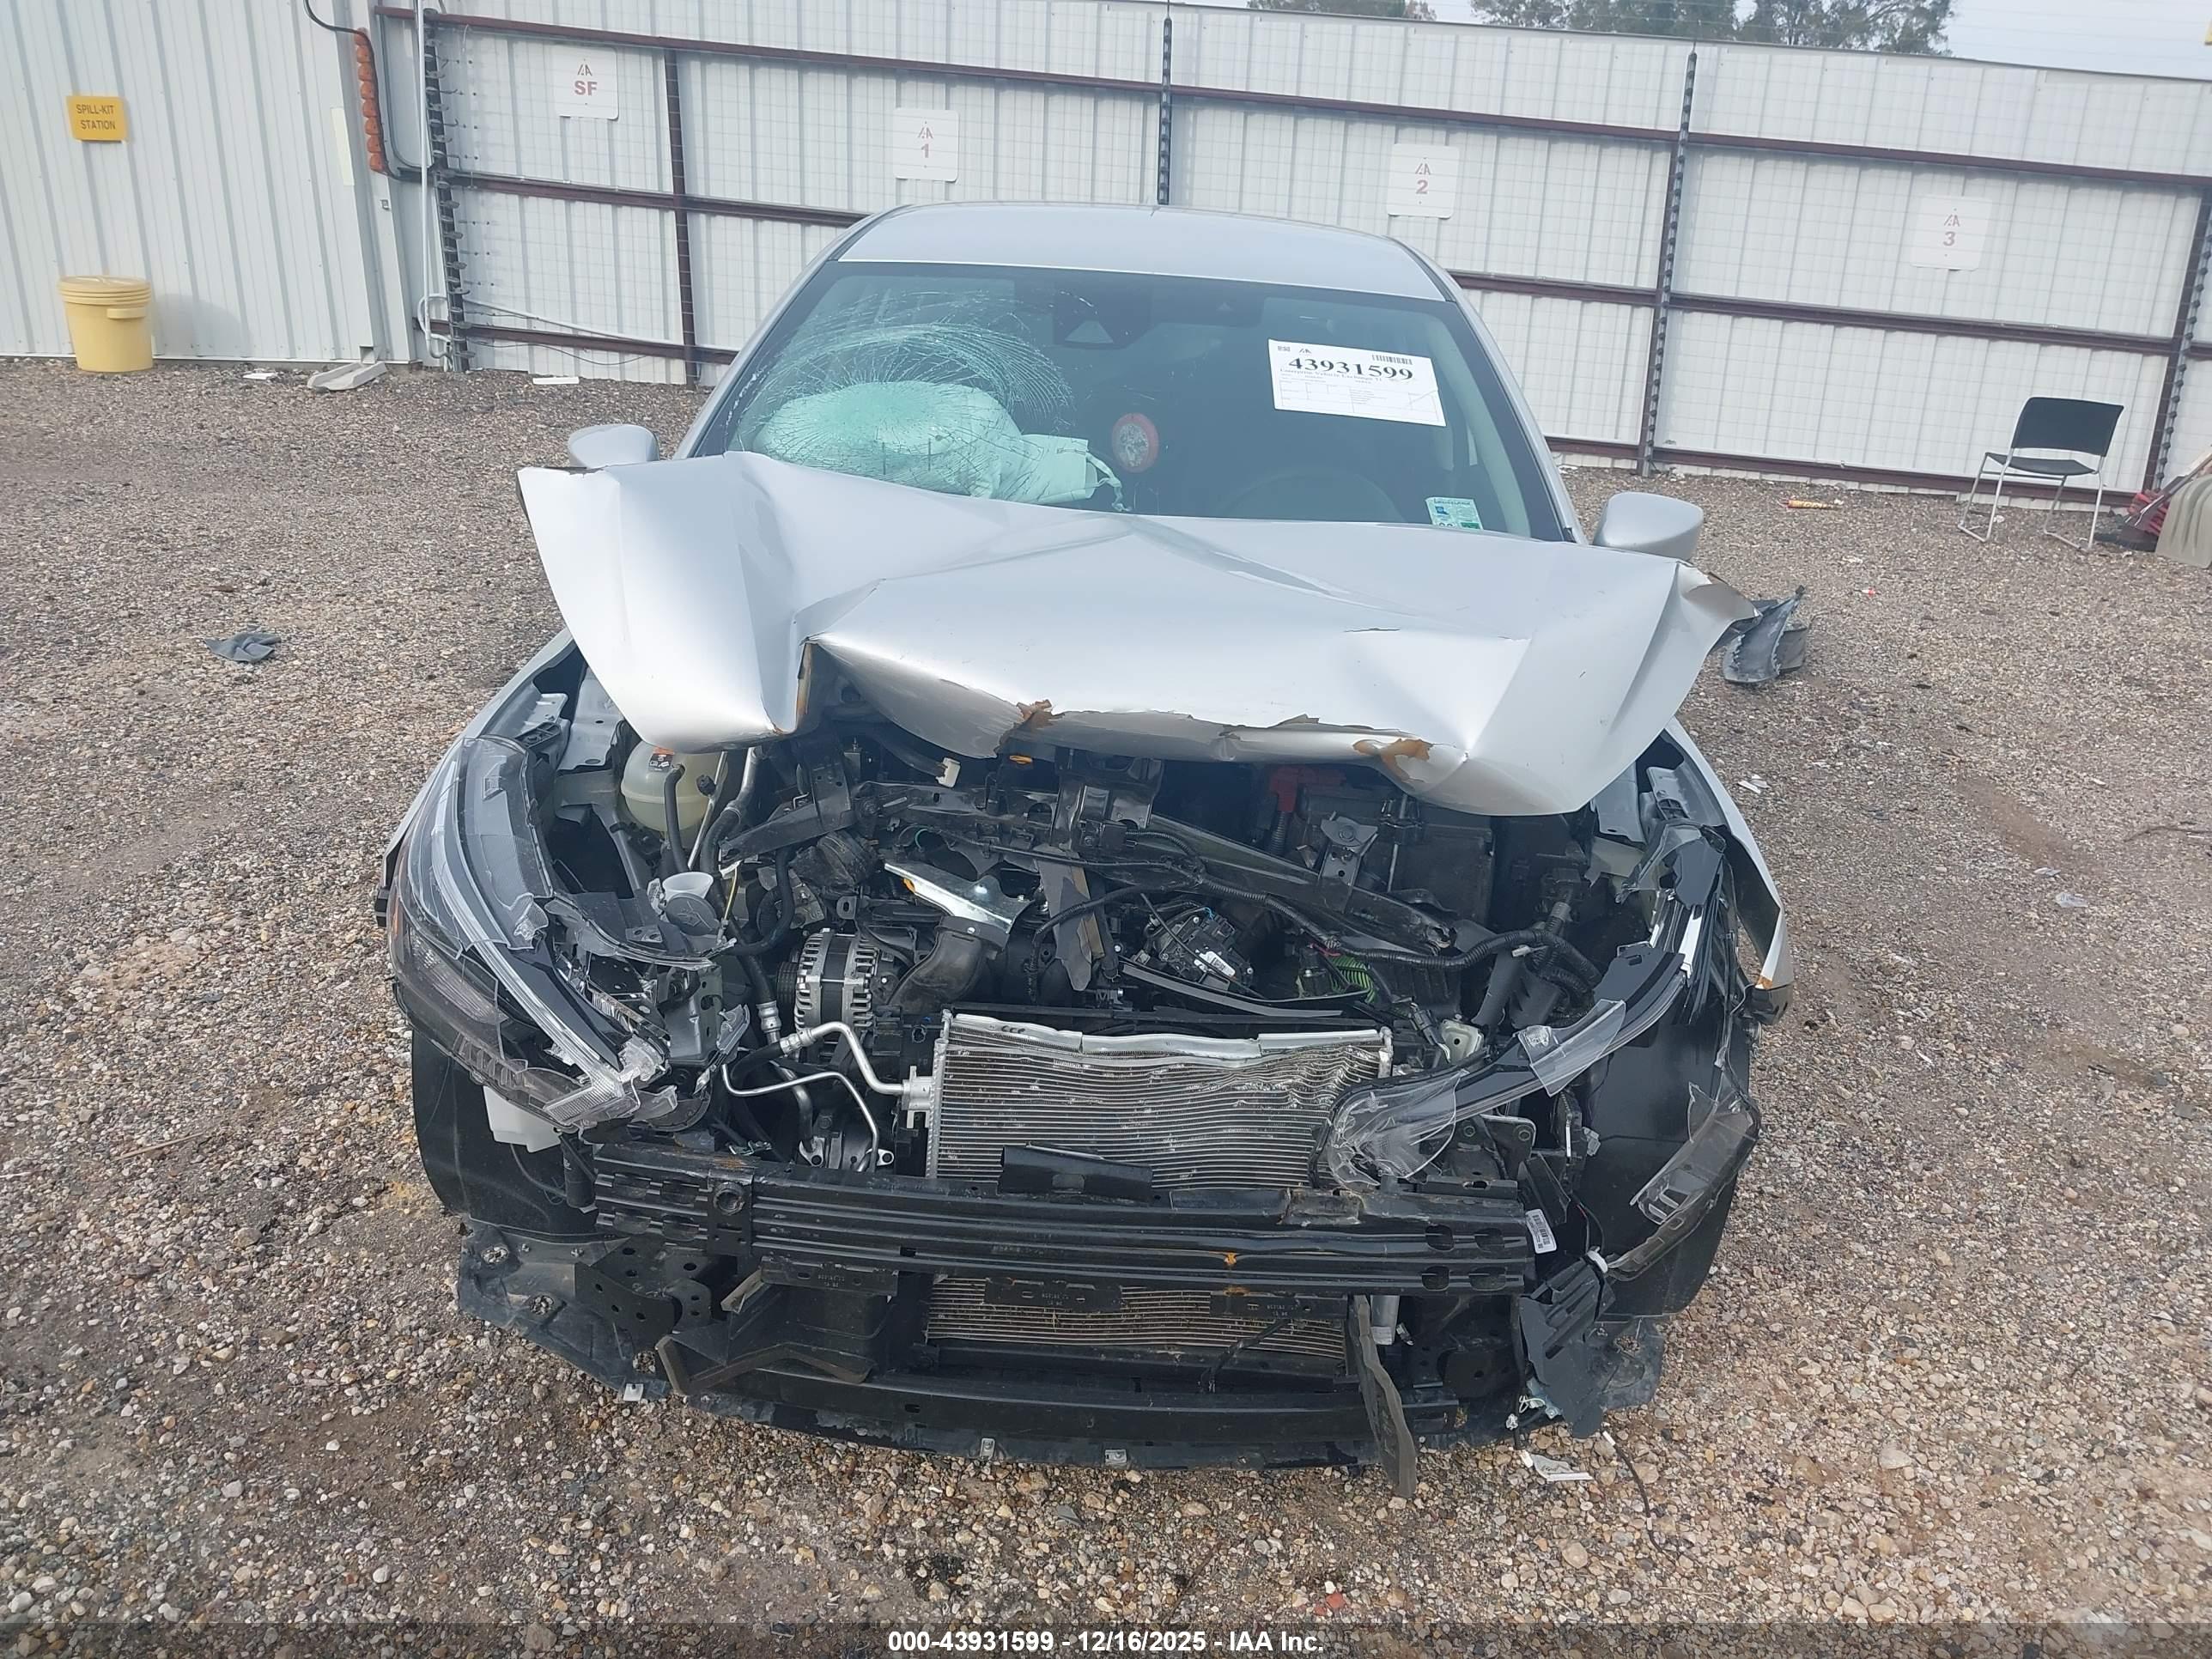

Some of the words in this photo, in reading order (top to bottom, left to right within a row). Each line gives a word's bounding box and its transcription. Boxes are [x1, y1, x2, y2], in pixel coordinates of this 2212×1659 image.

[574, 81, 598, 96] SF
[76, 104, 114, 114] SPILL-KIT
[81, 120, 116, 130] STATION
[921, 143, 929, 158] 1
[1416, 179, 1428, 194] 2
[1943, 231, 1955, 246] 3
[1288, 357, 1413, 380] 43931599
